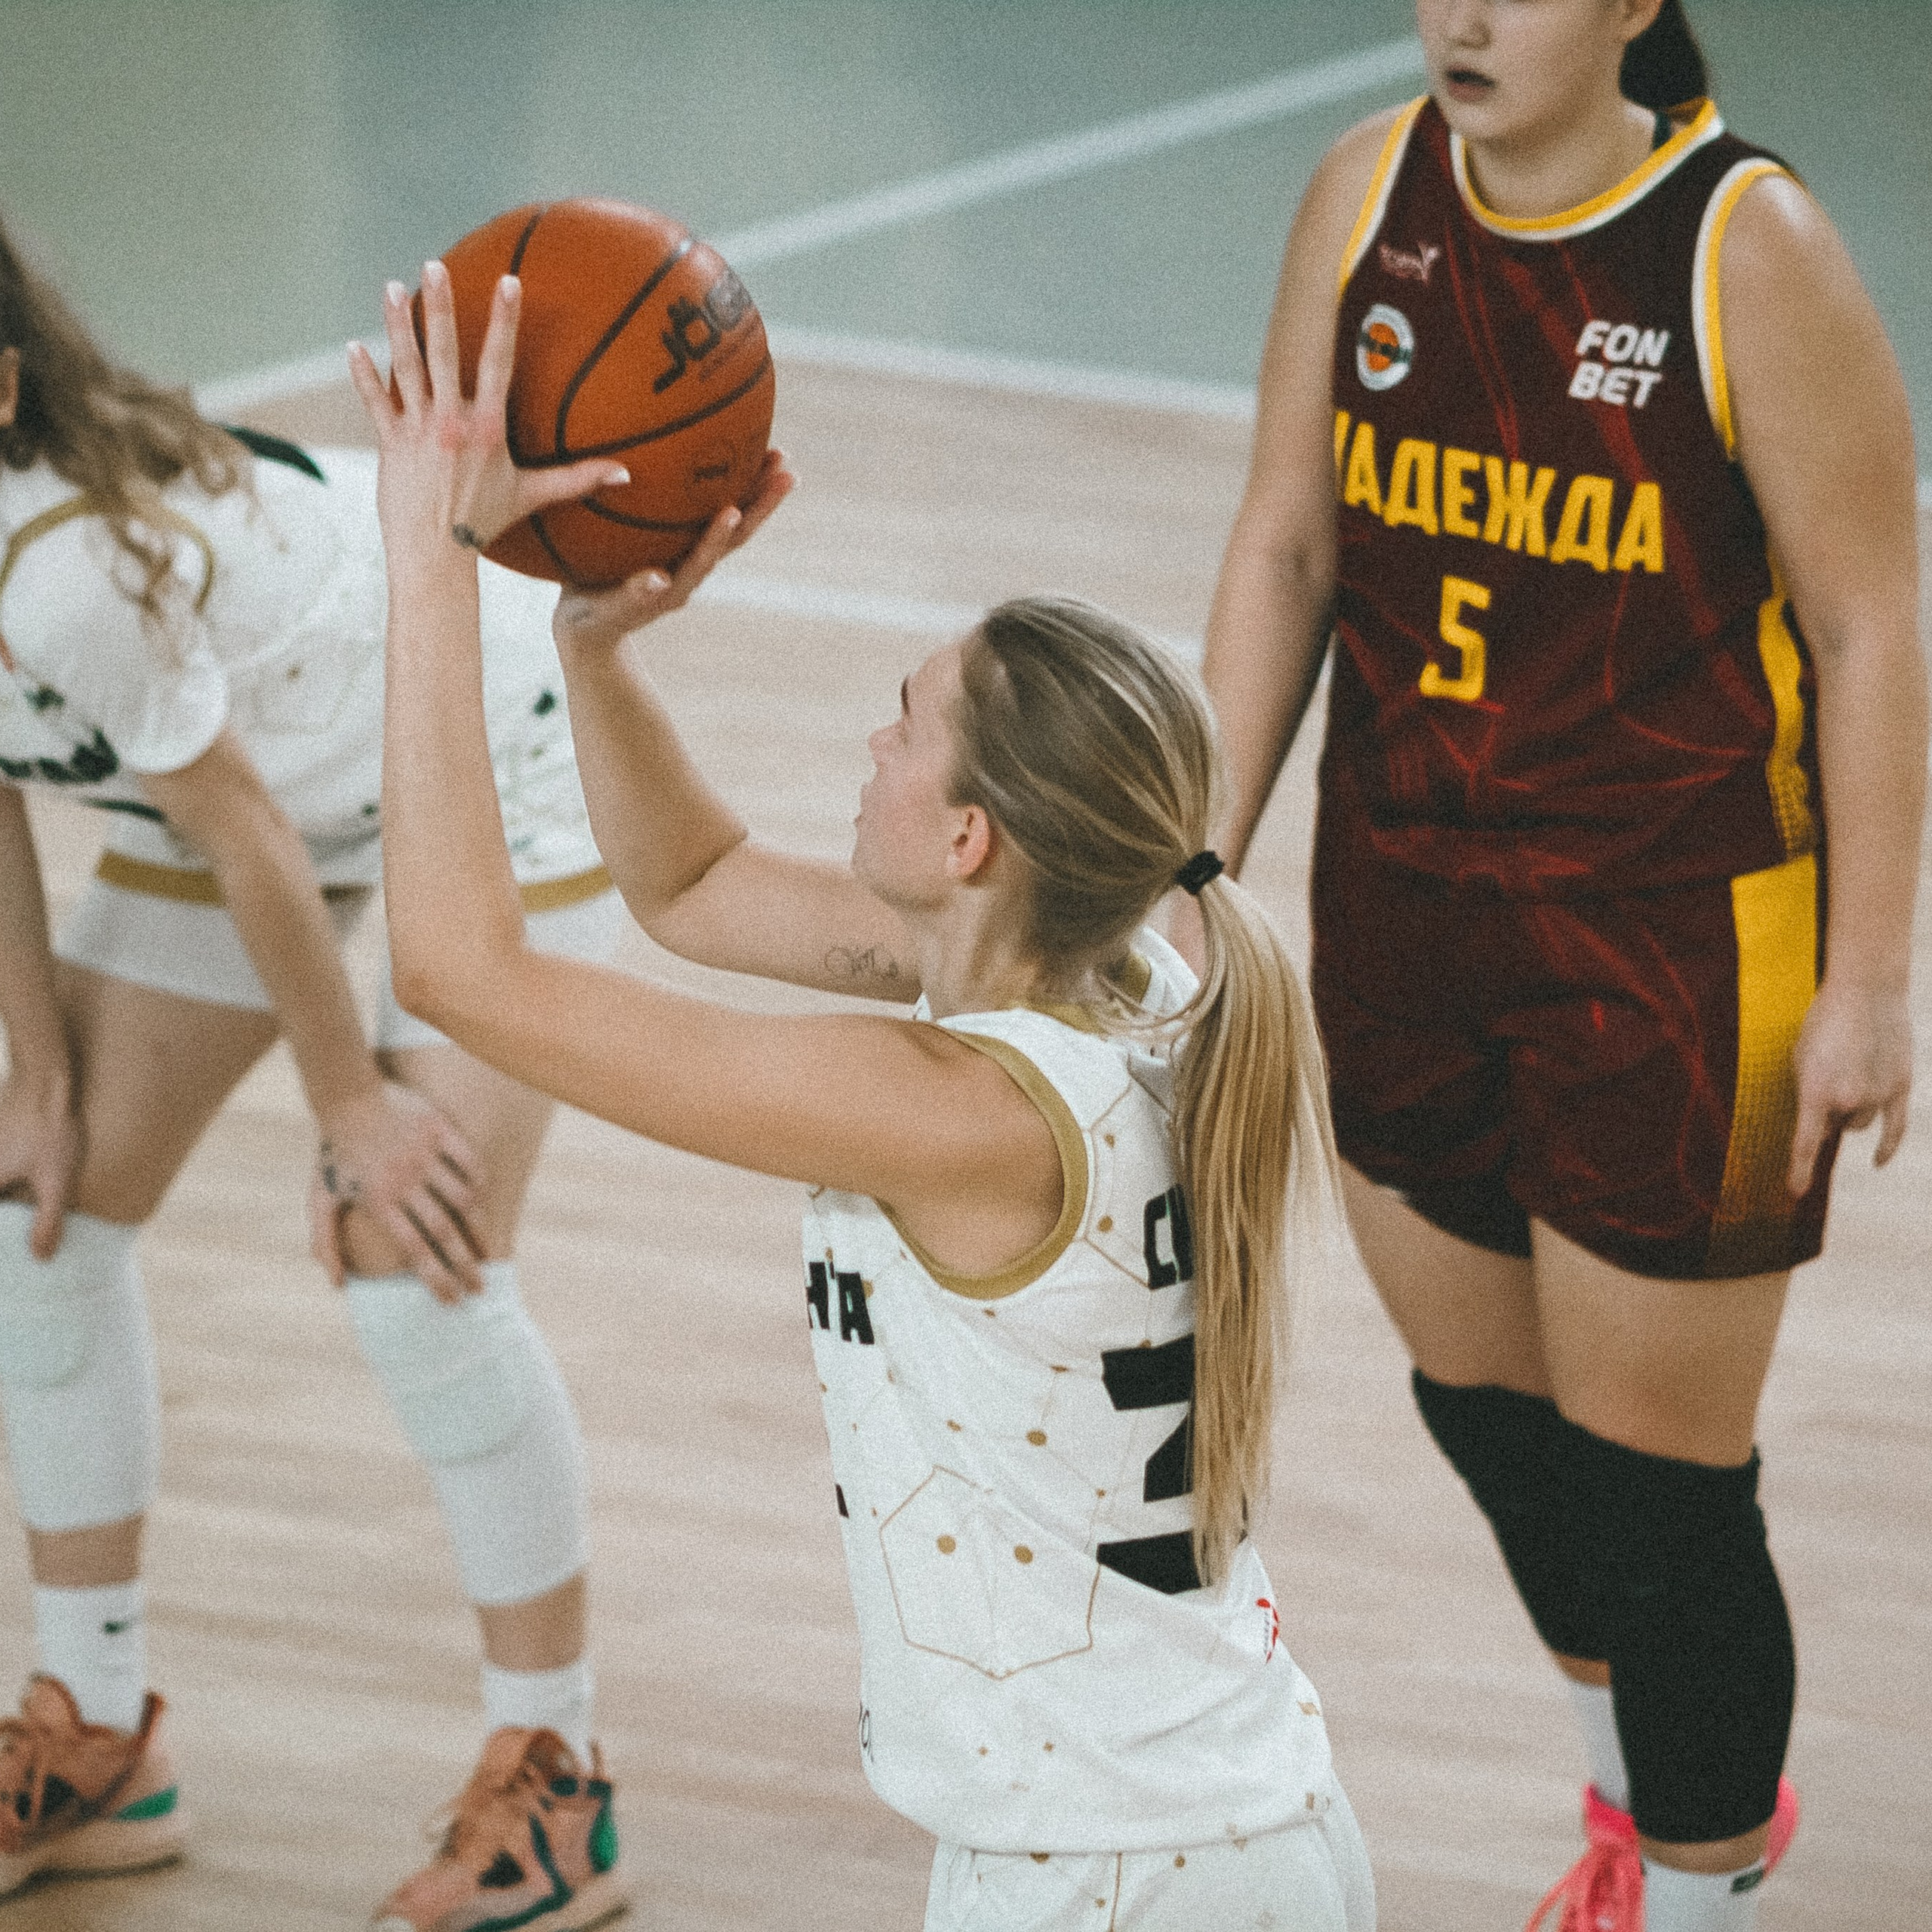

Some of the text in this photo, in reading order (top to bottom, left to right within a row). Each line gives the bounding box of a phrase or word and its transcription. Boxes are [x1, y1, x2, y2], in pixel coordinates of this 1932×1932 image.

[1576, 319, 1670, 368] FON
[1567, 361, 1663, 409] BET
[1419, 575, 1491, 703] 5
